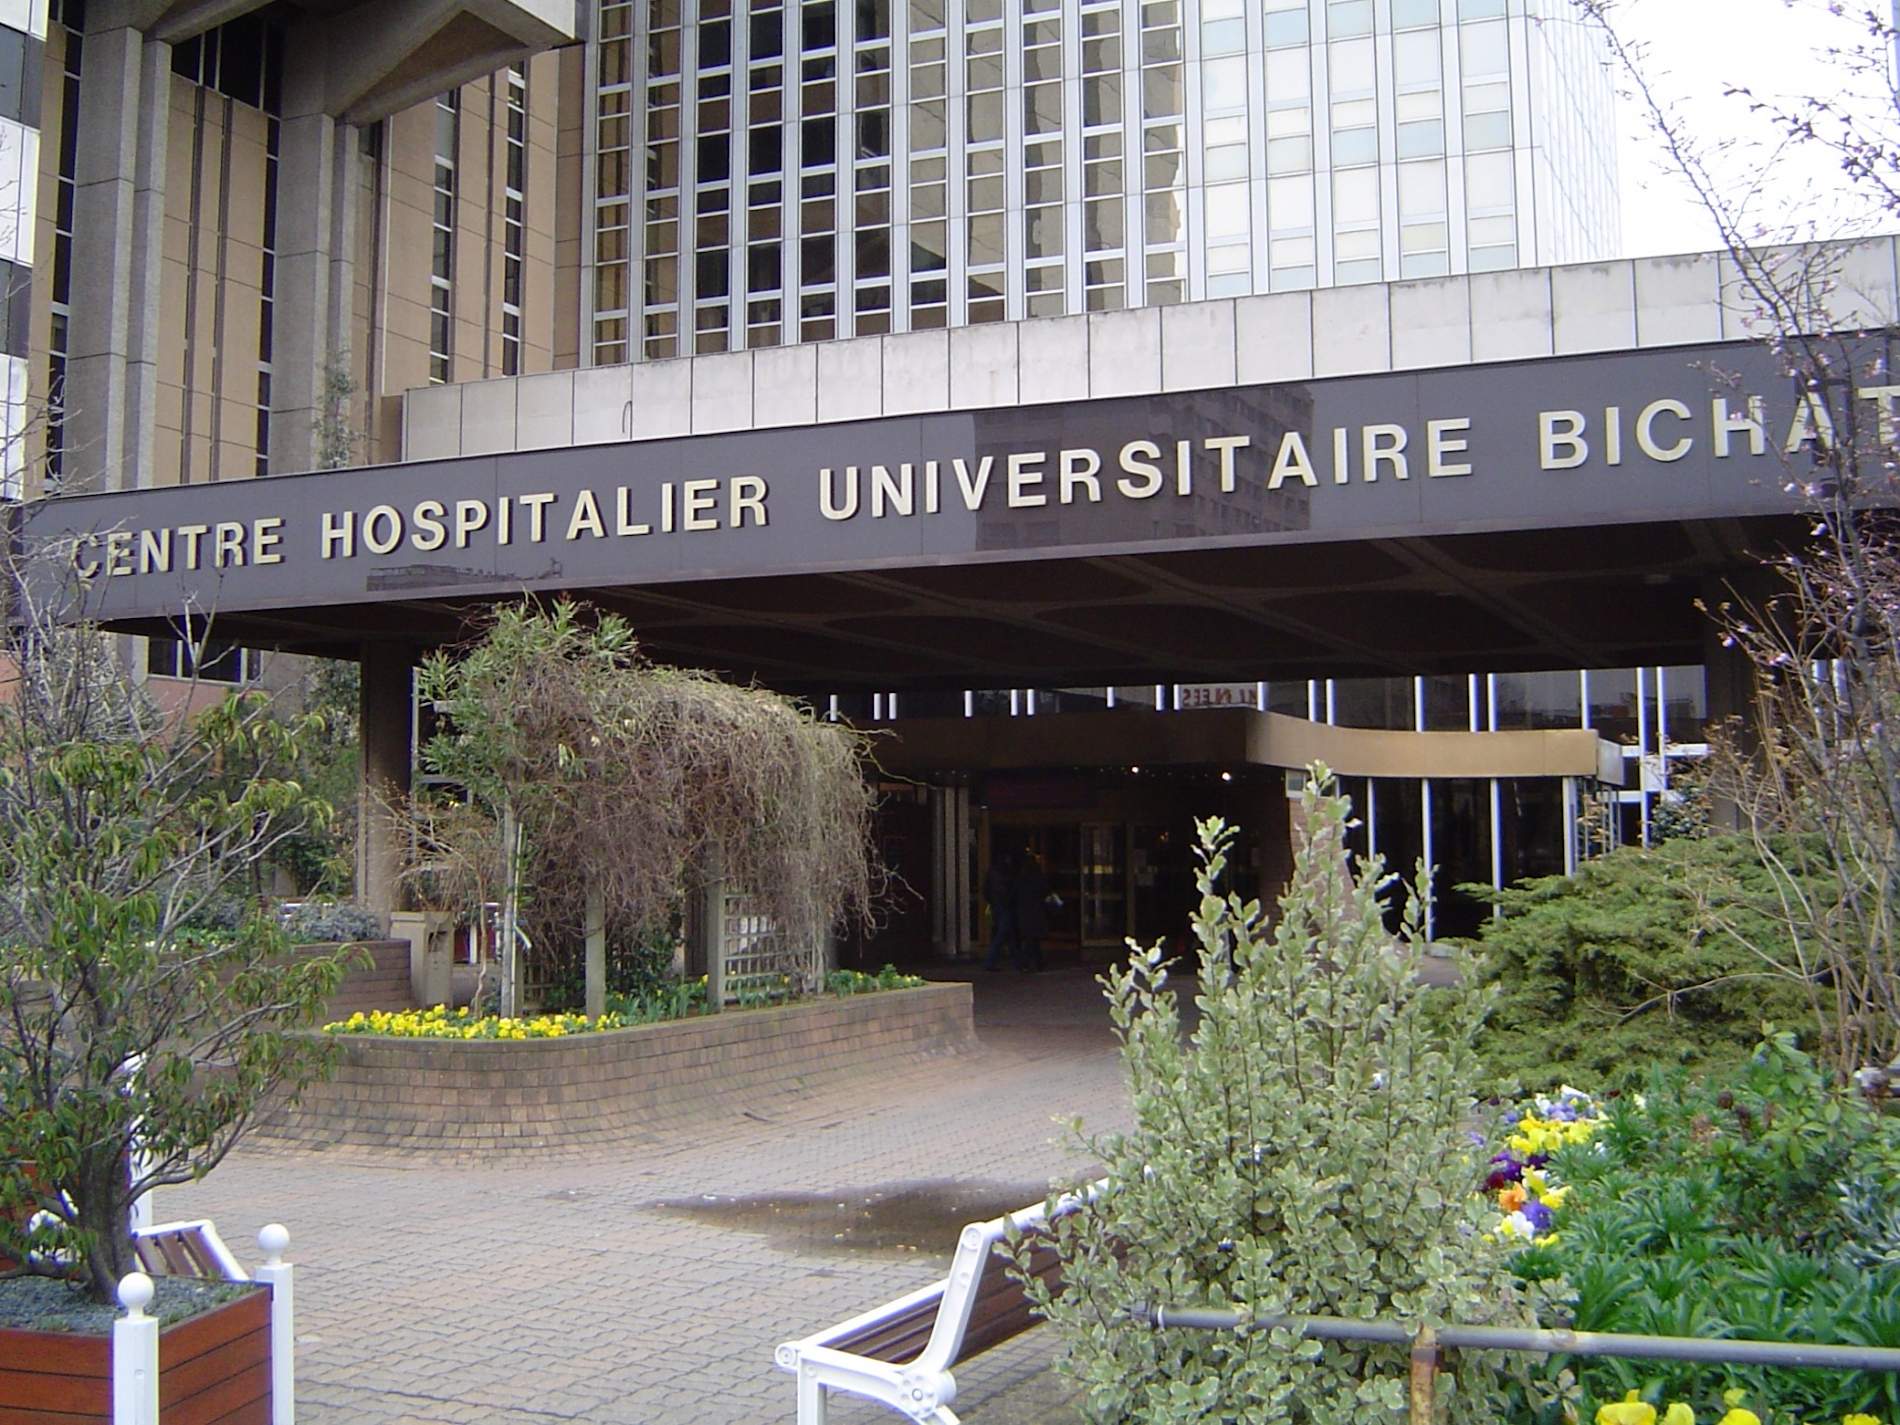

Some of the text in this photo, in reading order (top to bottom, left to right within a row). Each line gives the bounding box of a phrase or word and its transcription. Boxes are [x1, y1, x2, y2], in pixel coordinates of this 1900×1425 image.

[69, 385, 1900, 578] CENTRE HOSPITALIER UNIVERSITAIRE BICHAT
